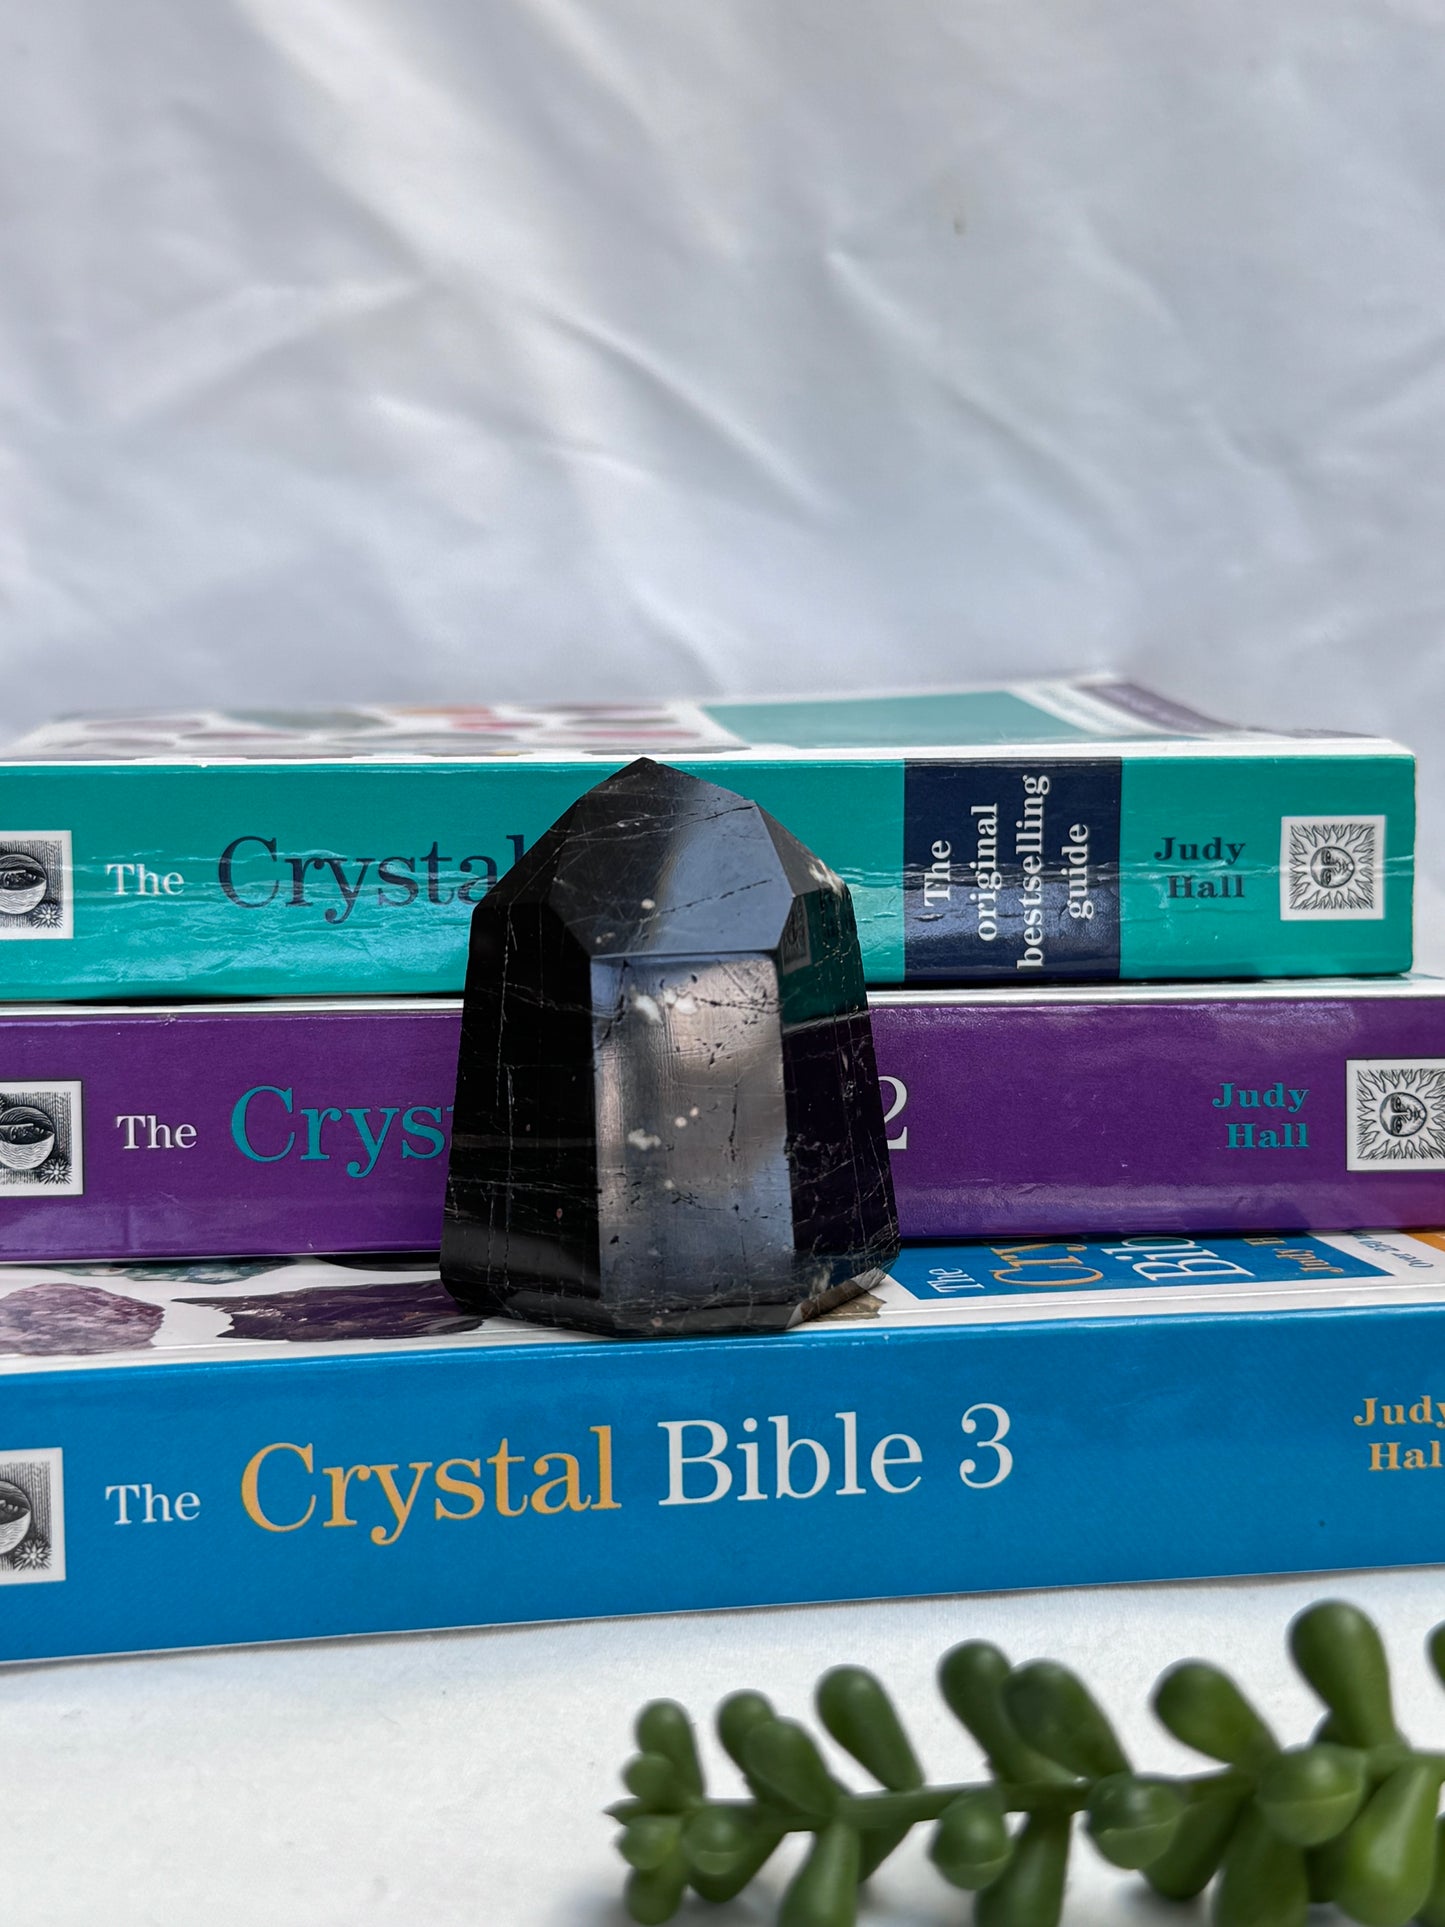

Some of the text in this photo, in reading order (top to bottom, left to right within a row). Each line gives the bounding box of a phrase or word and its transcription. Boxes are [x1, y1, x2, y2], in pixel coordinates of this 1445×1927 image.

[1154, 836, 1246, 863] Judy
[107, 863, 184, 896] The
[924, 839, 953, 907] The
[971, 803, 999, 942] original
[1016, 774, 1050, 970] bestselling
[1062, 823, 1094, 921] guide
[1166, 874, 1245, 900] Hall
[1212, 1082, 1309, 1113] Judy
[116, 1075, 908, 1179] The Crys 2
[1225, 1123, 1309, 1149] Hall
[1272, 1248, 1344, 1273] Judy
[926, 1266, 985, 1293] The
[105, 1402, 1014, 1545] The Crystal Bible 3
